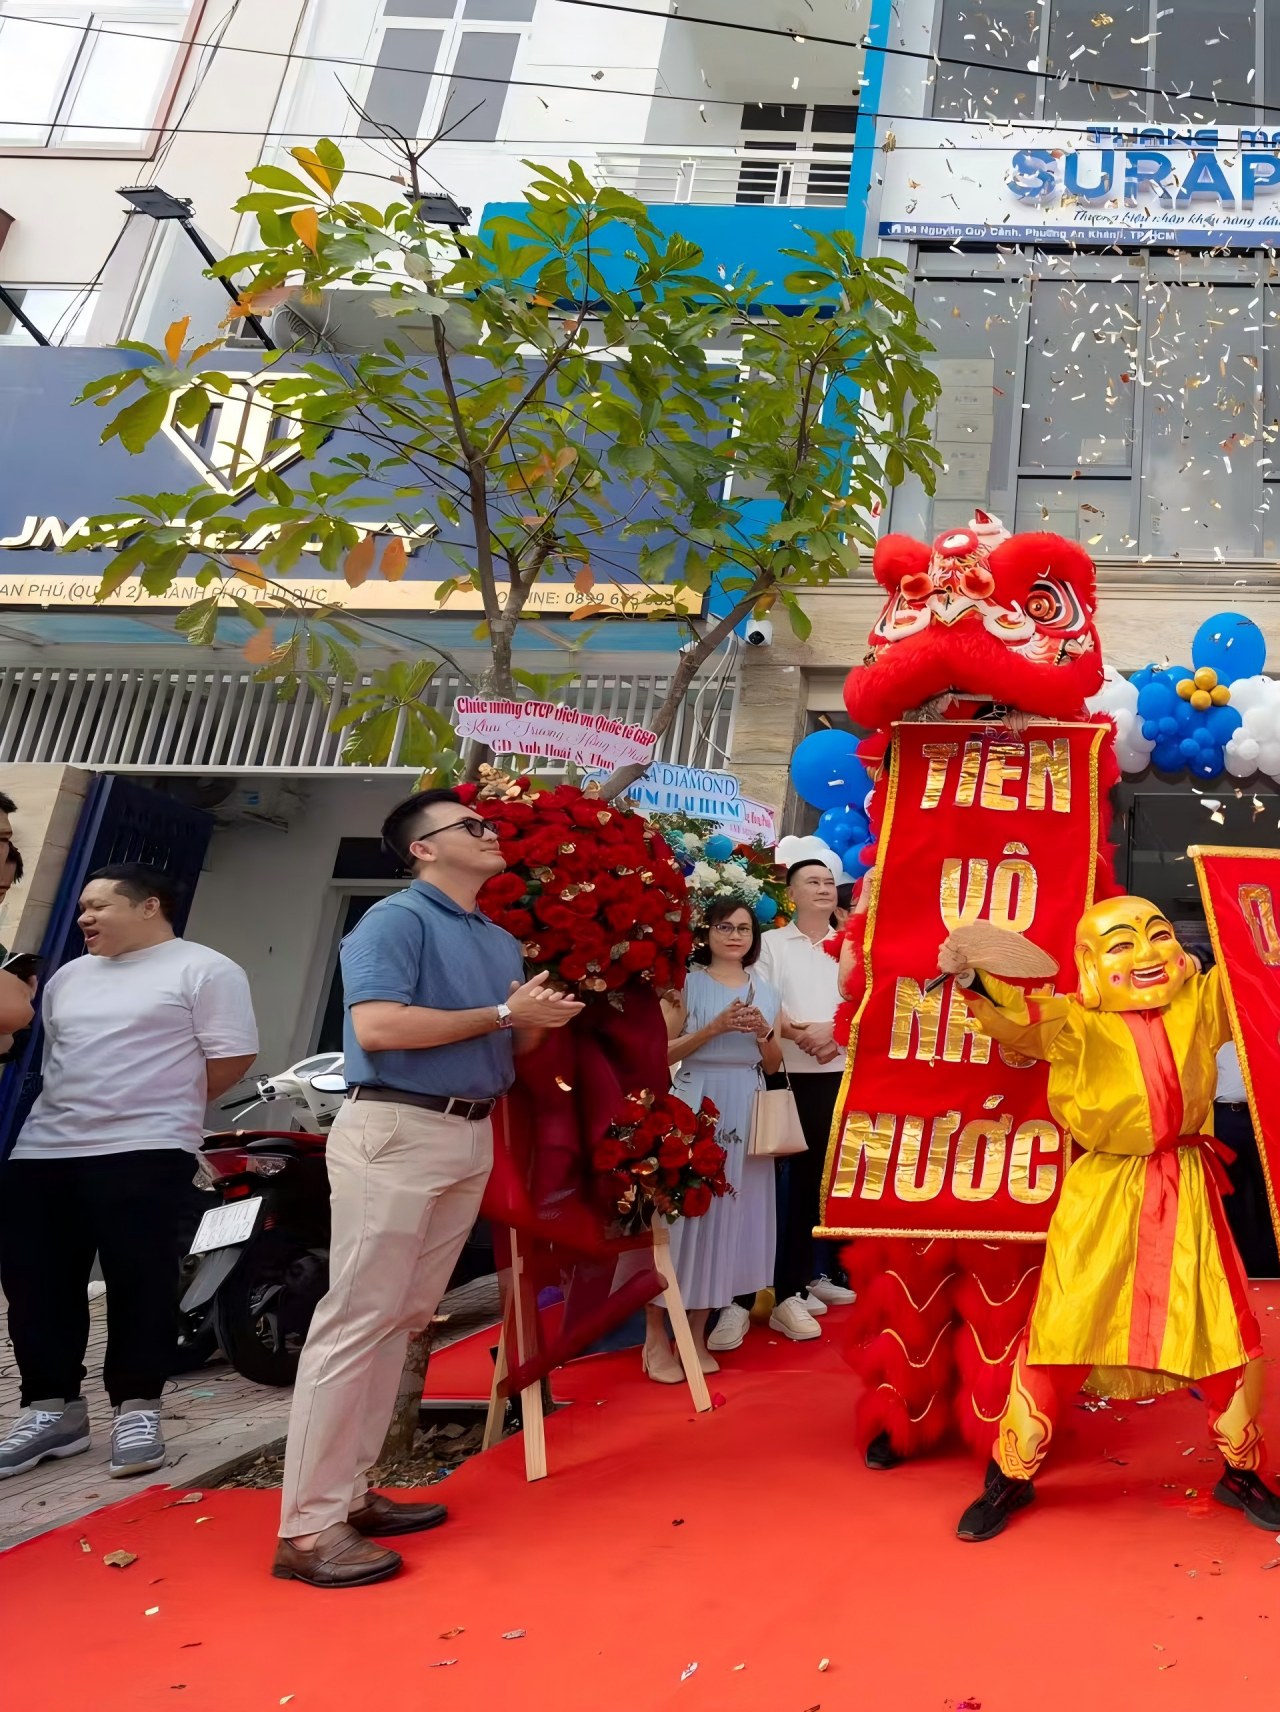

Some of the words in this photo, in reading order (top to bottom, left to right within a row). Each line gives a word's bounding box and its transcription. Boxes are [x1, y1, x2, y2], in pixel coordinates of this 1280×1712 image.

[1187, 212, 1220, 227] khu
[1130, 229, 1176, 241] TPHCM
[524, 701, 554, 719] CTCP
[663, 768, 736, 796] DIAMOND
[939, 841, 1038, 934] VÔ
[888, 976, 1056, 1069] NH
[831, 1094, 1060, 1205] NƯỚC
